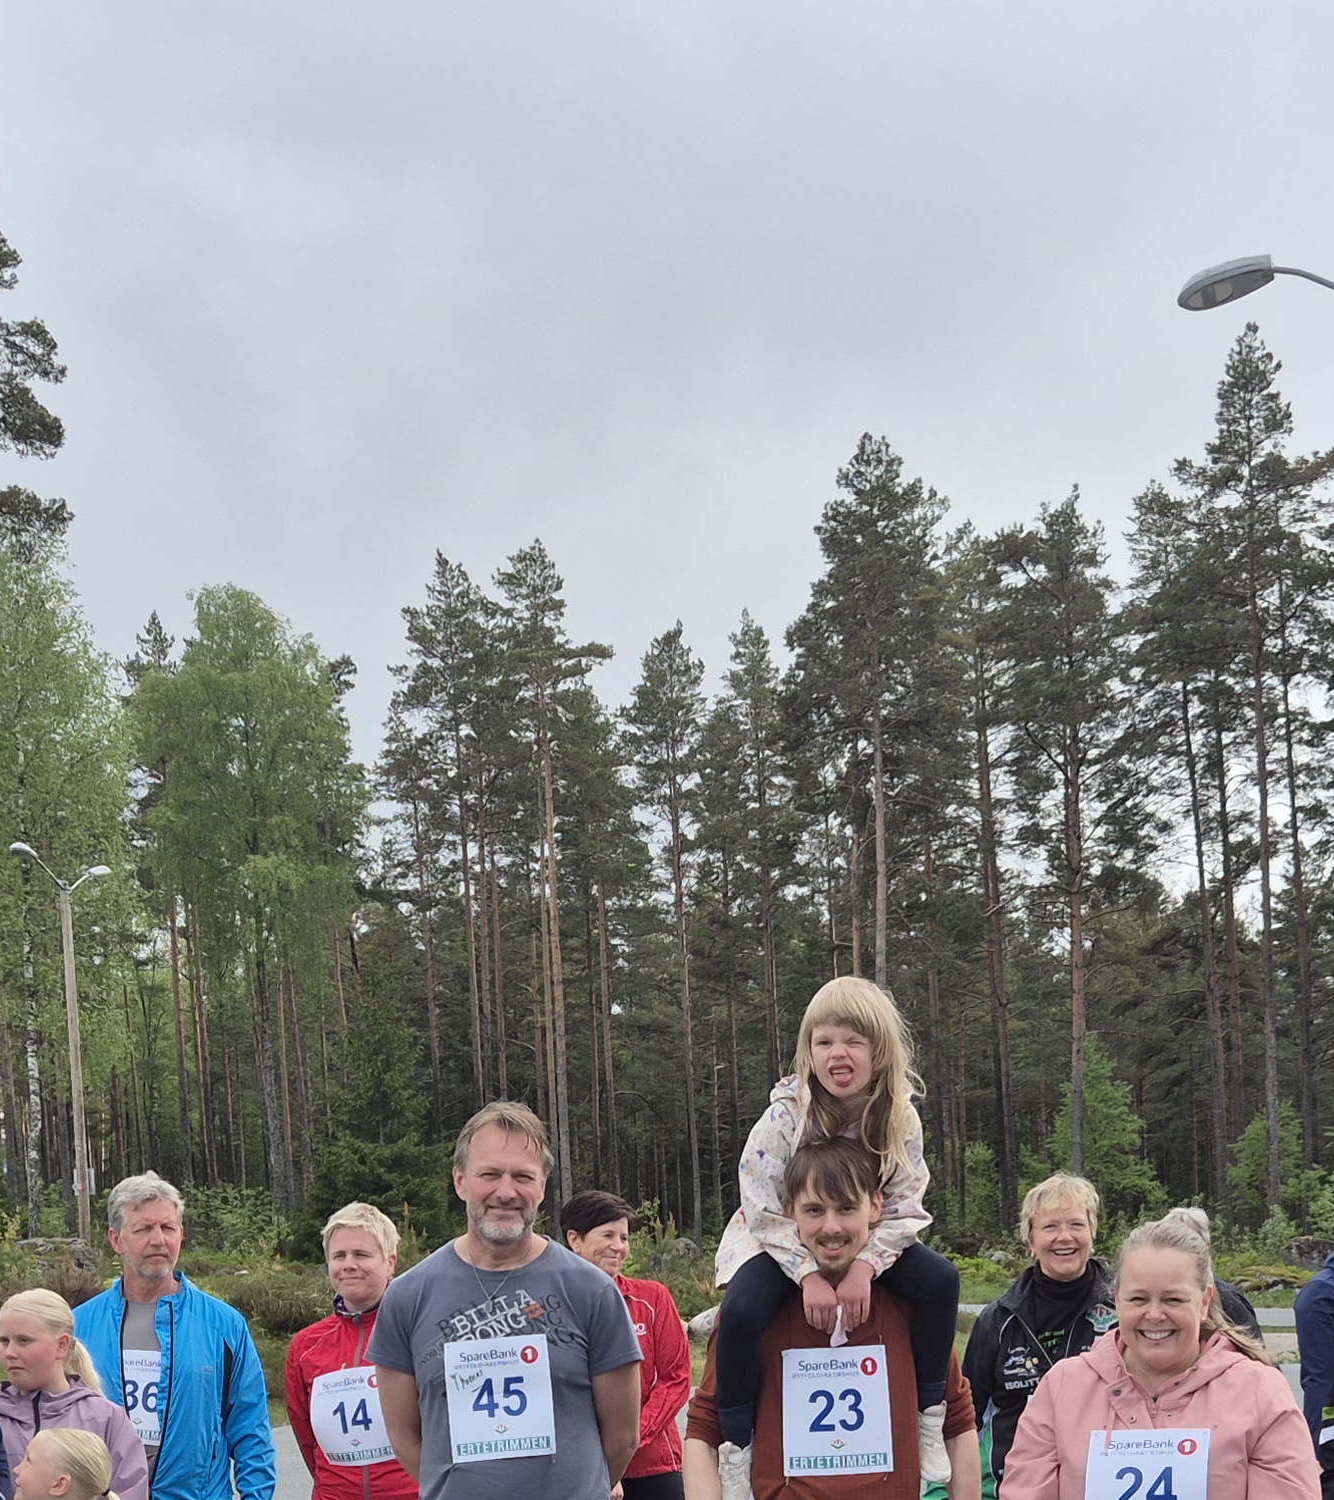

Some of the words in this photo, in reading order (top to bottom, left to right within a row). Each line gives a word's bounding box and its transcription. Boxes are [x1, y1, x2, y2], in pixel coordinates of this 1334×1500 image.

[459, 1348, 518, 1363] SpareBank
[798, 1359, 858, 1372] SpareBank
[322, 1377, 365, 1390] SpareBank
[473, 1376, 527, 1418] 45
[332, 1399, 373, 1434] 14
[808, 1389, 864, 1432] 23
[460, 1437, 547, 1456] ERTETRIMMEN
[1107, 1439, 1174, 1450] SpareBank
[793, 1453, 884, 1469] ERTETRIMMEN
